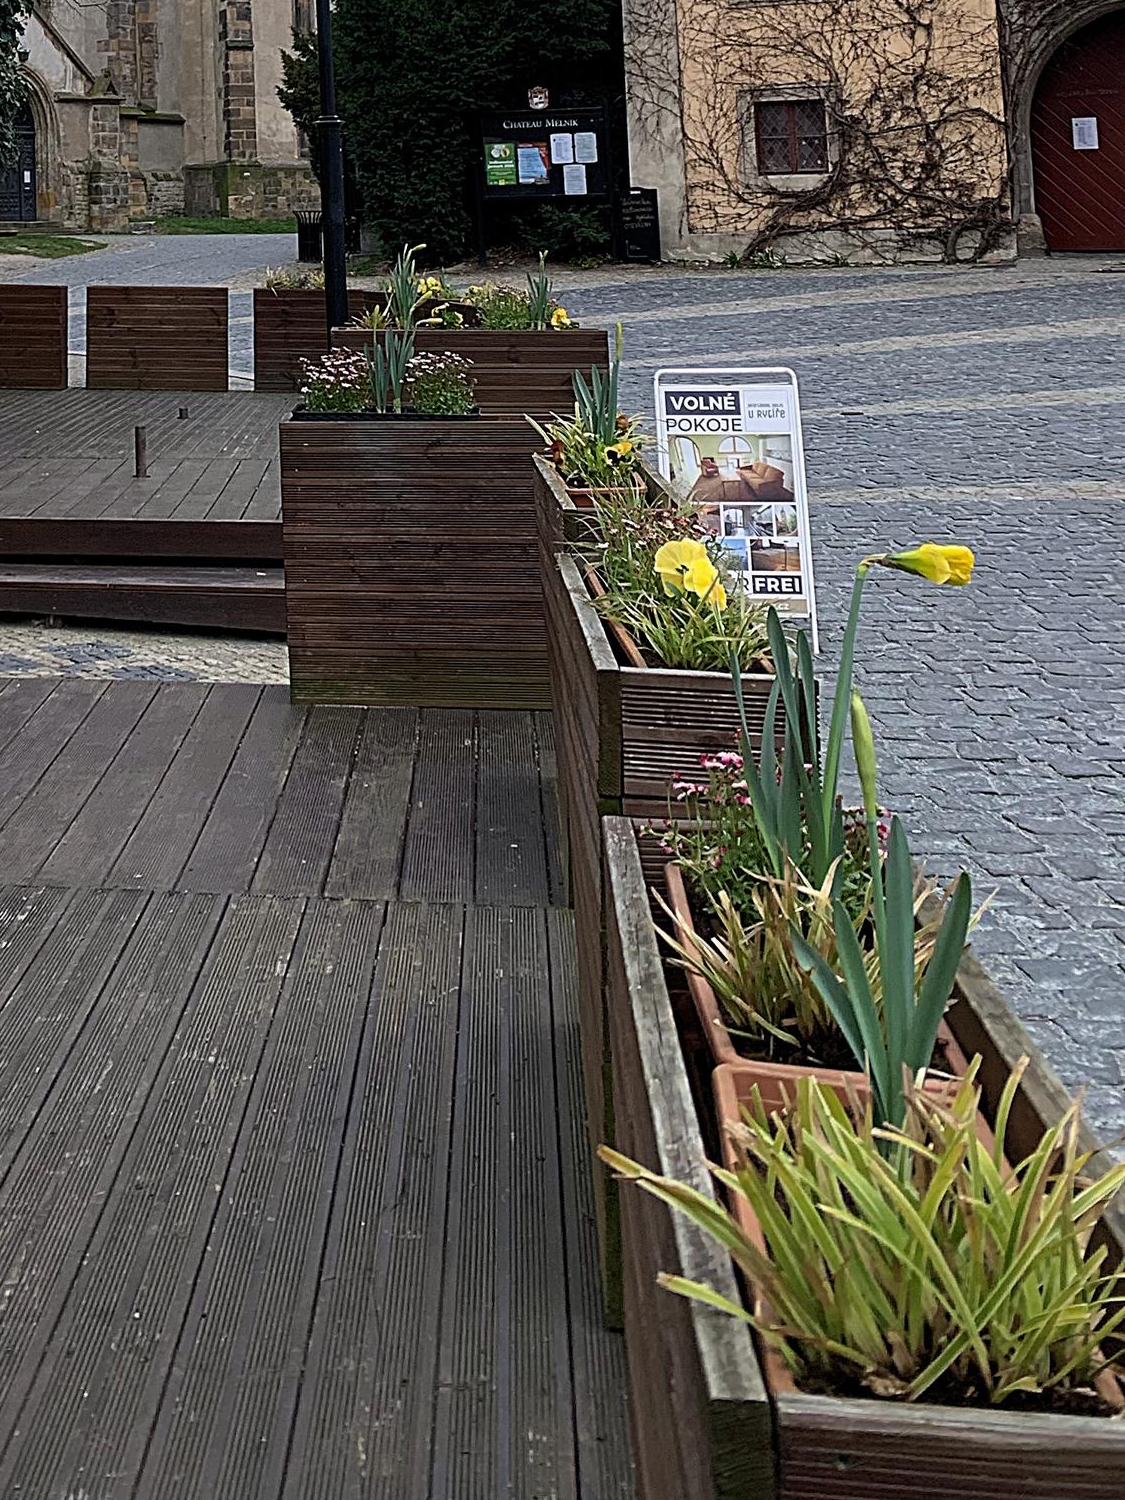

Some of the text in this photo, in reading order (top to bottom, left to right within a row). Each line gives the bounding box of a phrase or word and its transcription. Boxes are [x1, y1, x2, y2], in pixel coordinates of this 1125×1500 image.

[502, 120, 542, 129] CHATEAU
[669, 392, 736, 411] VOLNÉ
[747, 409, 754, 419] U
[666, 418, 743, 432] POKOJE
[754, 577, 801, 593] FREI
